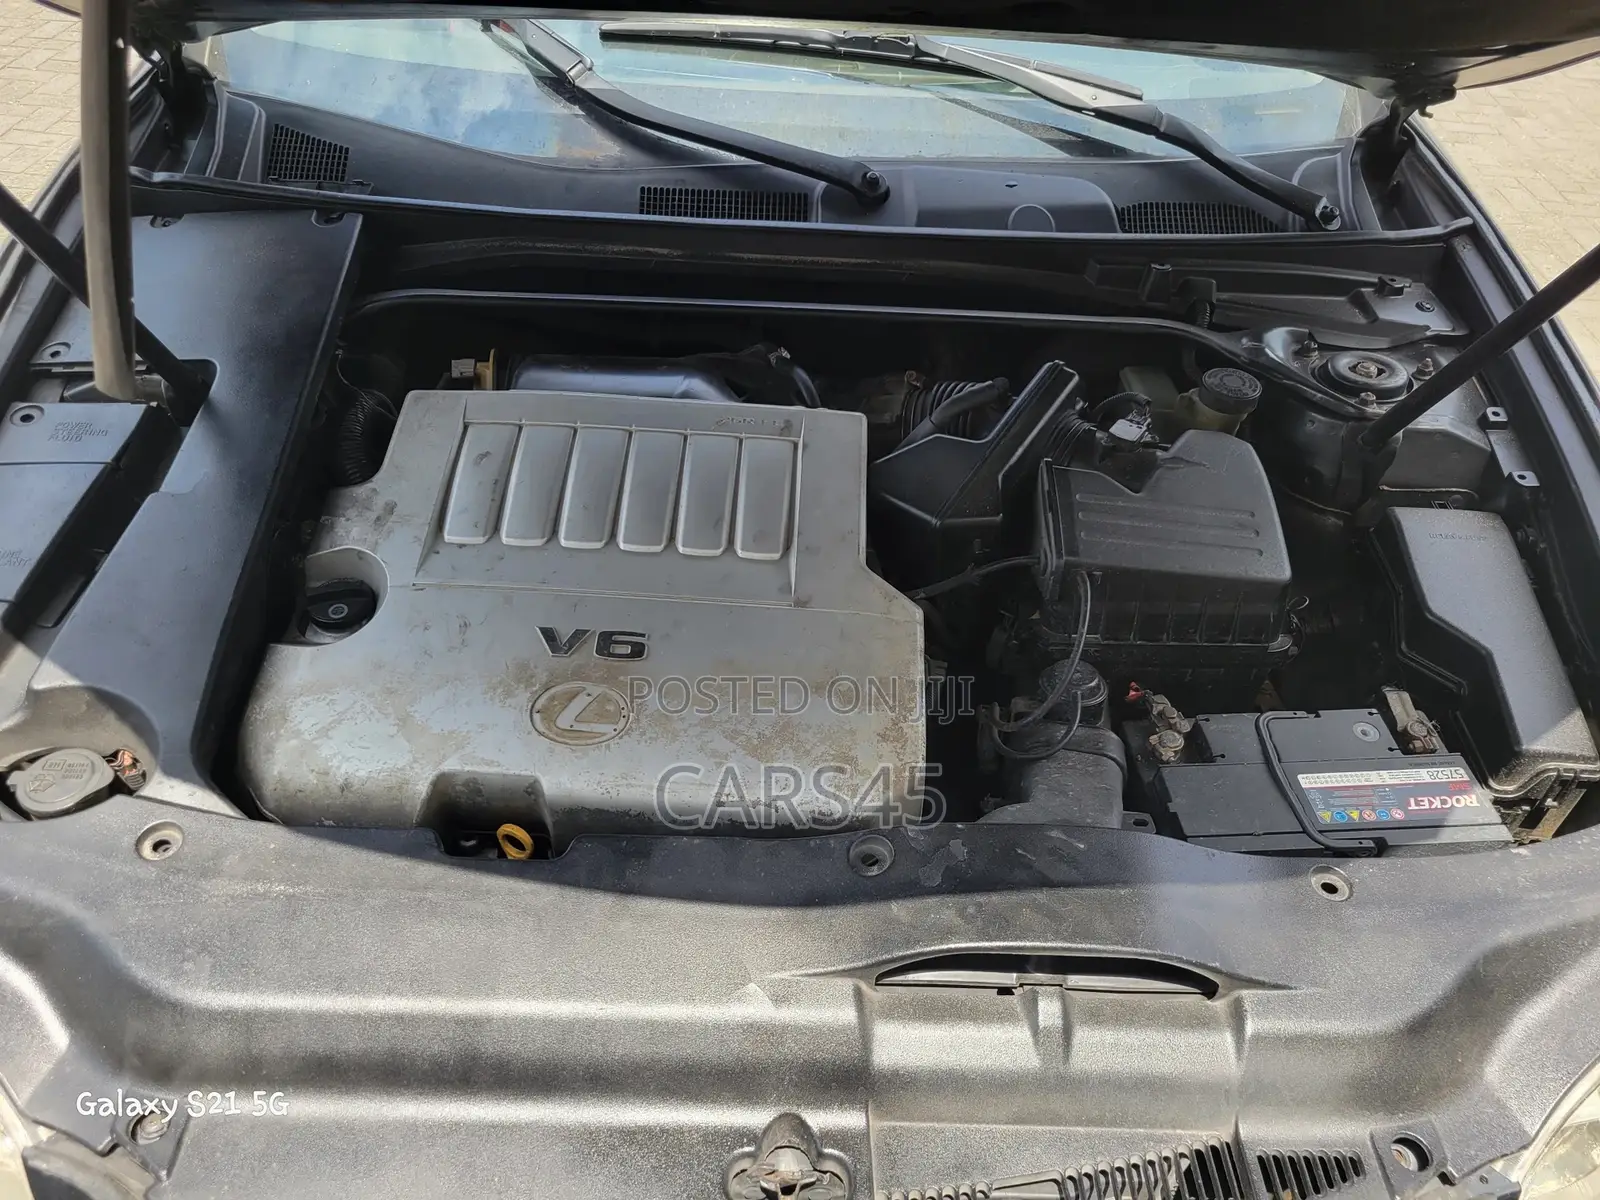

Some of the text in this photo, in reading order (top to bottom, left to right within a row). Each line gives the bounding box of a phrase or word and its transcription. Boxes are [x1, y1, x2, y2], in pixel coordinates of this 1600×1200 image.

[54, 421, 93, 430] POWER
[50, 428, 109, 437] STEERING
[535, 625, 650, 661] V6
[1426, 768, 1465, 780] 57528
[1407, 794, 1480, 810] ROCKET
